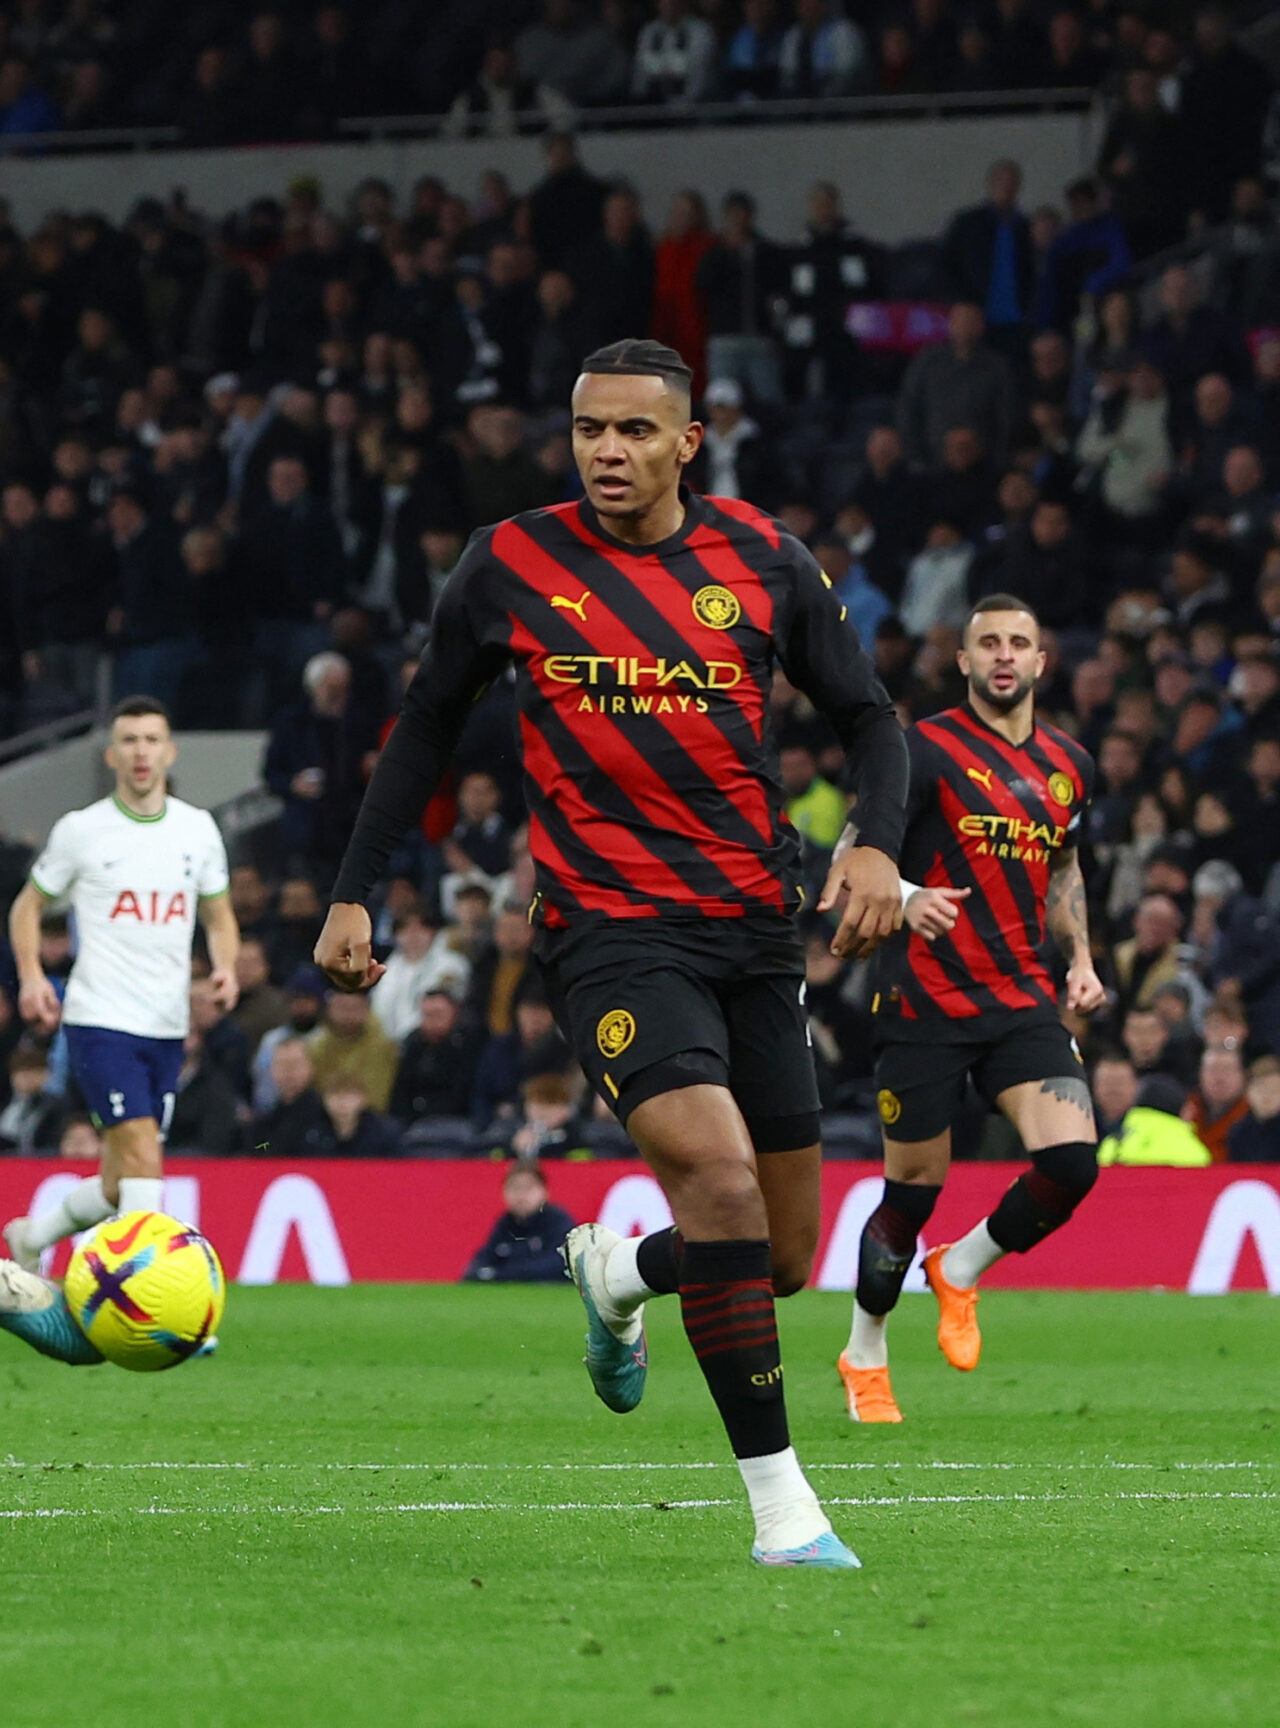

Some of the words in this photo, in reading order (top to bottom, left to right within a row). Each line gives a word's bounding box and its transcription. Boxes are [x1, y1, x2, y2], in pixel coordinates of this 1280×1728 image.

[544, 655, 742, 689] ETIHAD
[577, 694, 709, 714] AIRWAYS
[976, 841, 1051, 865] AIRWAYS
[109, 889, 187, 925] AIA
